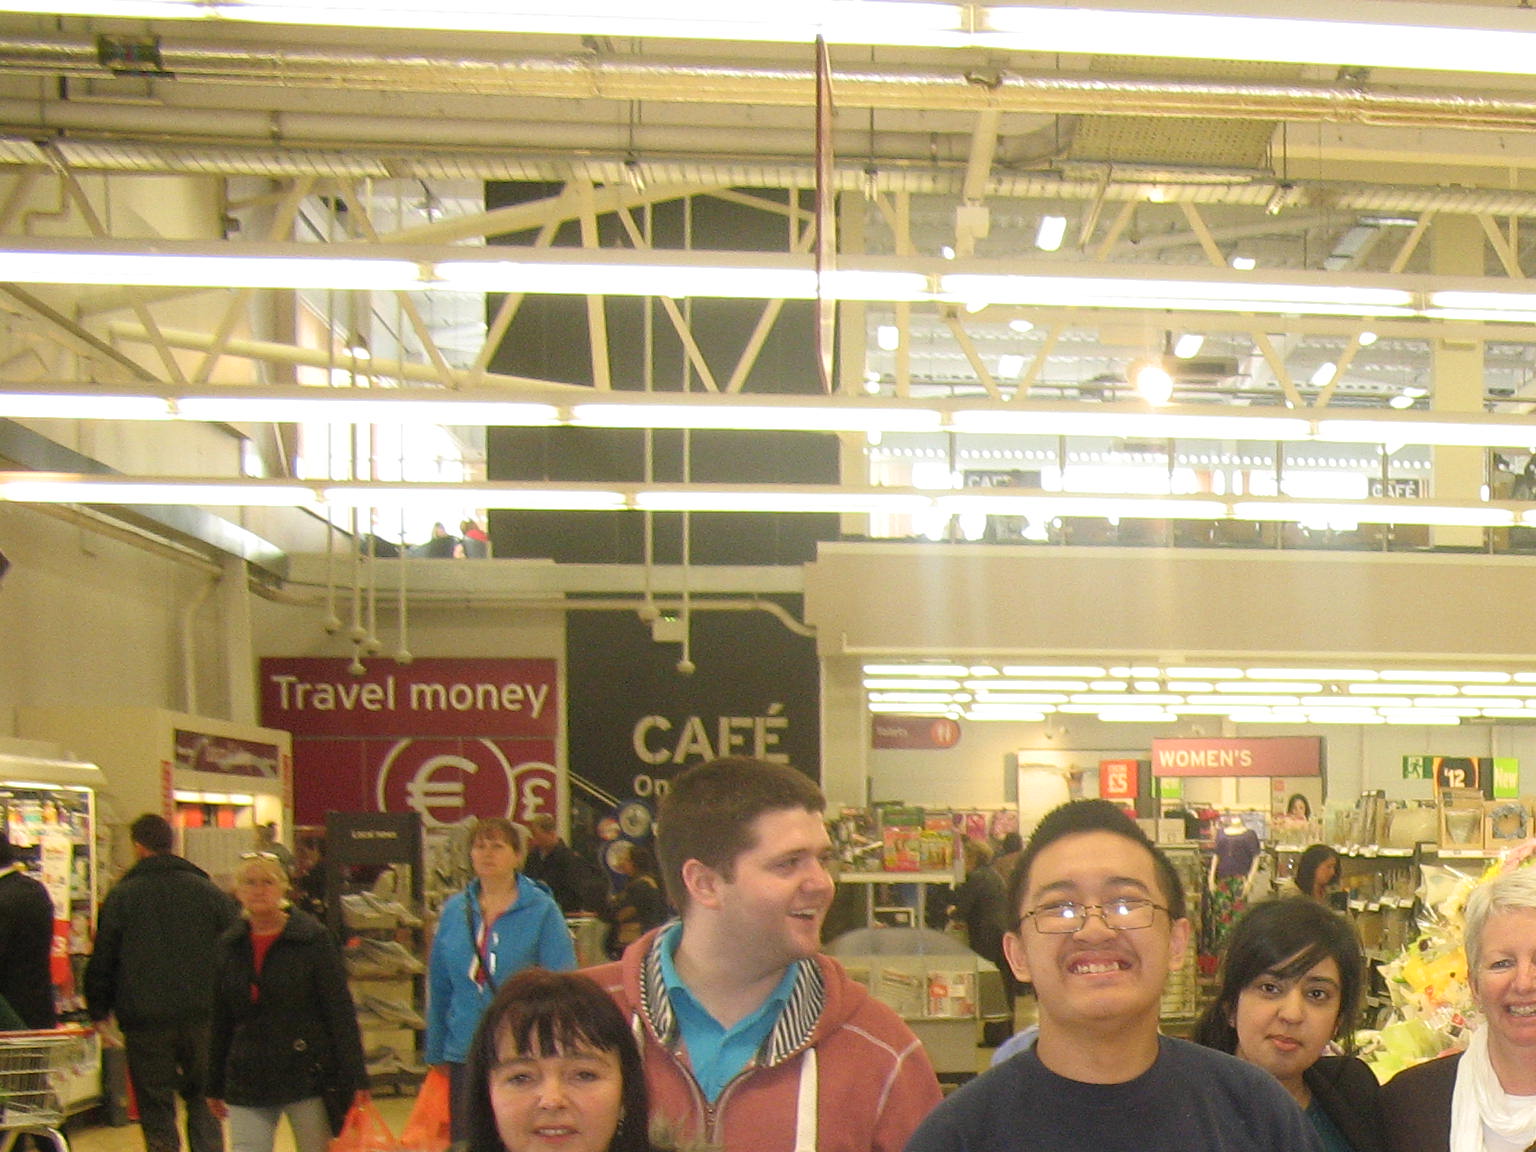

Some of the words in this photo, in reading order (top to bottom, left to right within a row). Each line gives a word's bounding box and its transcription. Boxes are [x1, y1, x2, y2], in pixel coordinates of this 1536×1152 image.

[270, 674, 396, 711] Travel
[410, 681, 549, 719] money
[632, 703, 791, 765] CAFÉ
[1158, 749, 1253, 768] WOMEN'S
